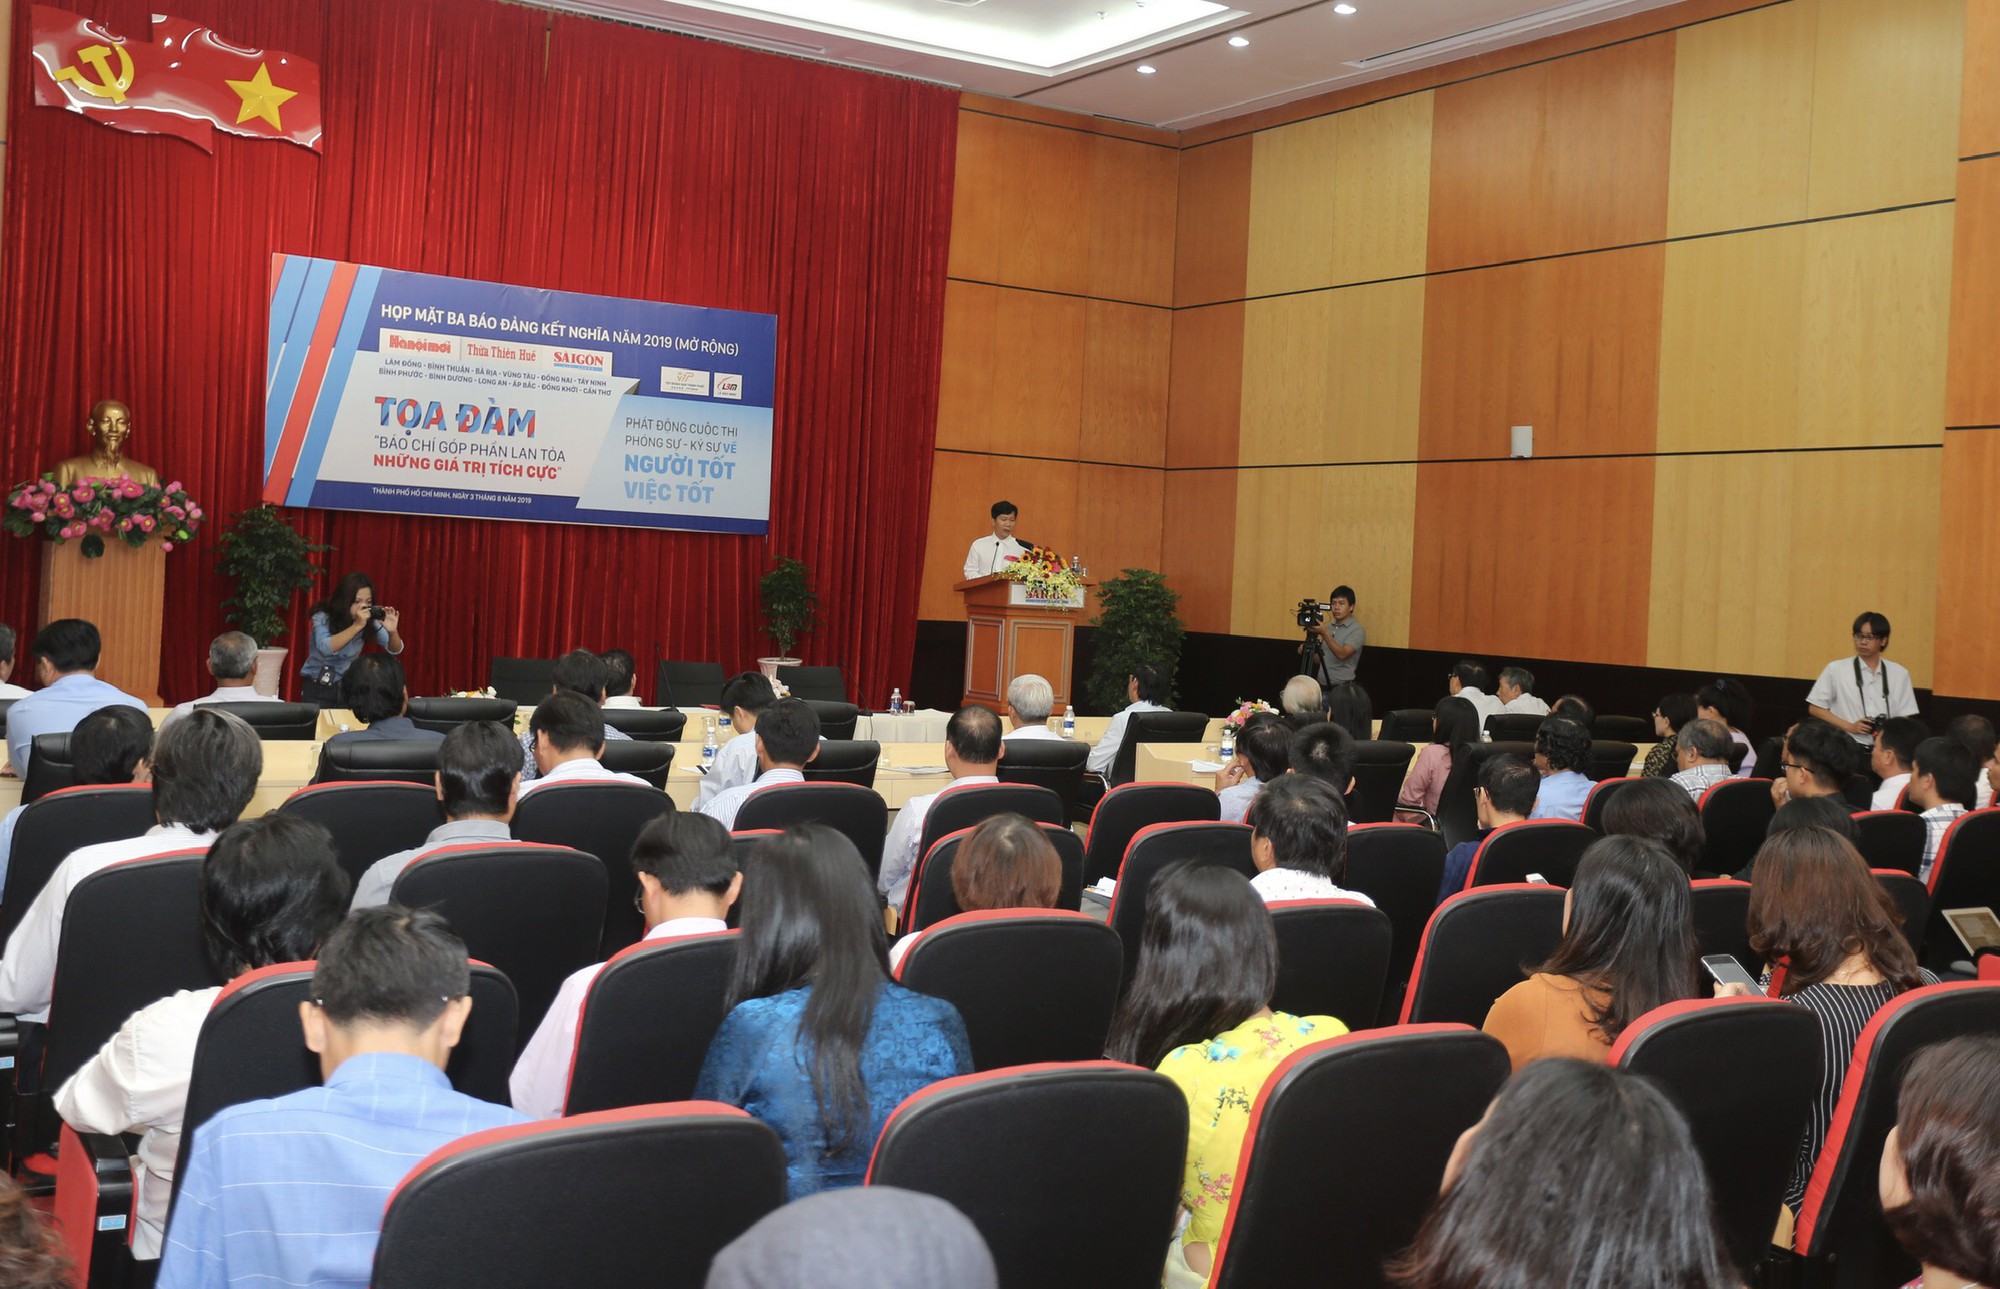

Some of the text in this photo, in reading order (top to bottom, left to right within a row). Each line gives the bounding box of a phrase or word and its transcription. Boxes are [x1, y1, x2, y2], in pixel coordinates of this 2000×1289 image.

[382, 304, 739, 357] HỌP MẶT BA BÁO ĐẢNG KẾT NGHĨA NĂM 2019 (MỞ RỘNG)
[467, 344, 536, 361] Thừa Thiên Huế
[375, 396, 536, 438] TỌA ĐÀM
[626, 416, 738, 437] PHÁT ĐỘNG CUỘC THI
[412, 437, 435, 452] CHÍ
[439, 439, 467, 455] GÓP
[470, 440, 508, 458] PHẦN
[512, 448, 538, 460] LAN
[541, 447, 566, 462] TỎA
[626, 434, 663, 448] PHÓNG
[666, 438, 682, 451] SỰ
[691, 439, 704, 451] KÝ
[706, 442, 721, 455] SỰ
[723, 441, 737, 454] VỀ
[374, 453, 431, 470] NHỮNG
[434, 456, 459, 472] GIÁ
[463, 461, 486, 478] TRỊ
[490, 461, 523, 477] TÍCH
[625, 453, 736, 480] NGƯỜI TỐT
[624, 478, 714, 505] VIỆC TỐT
